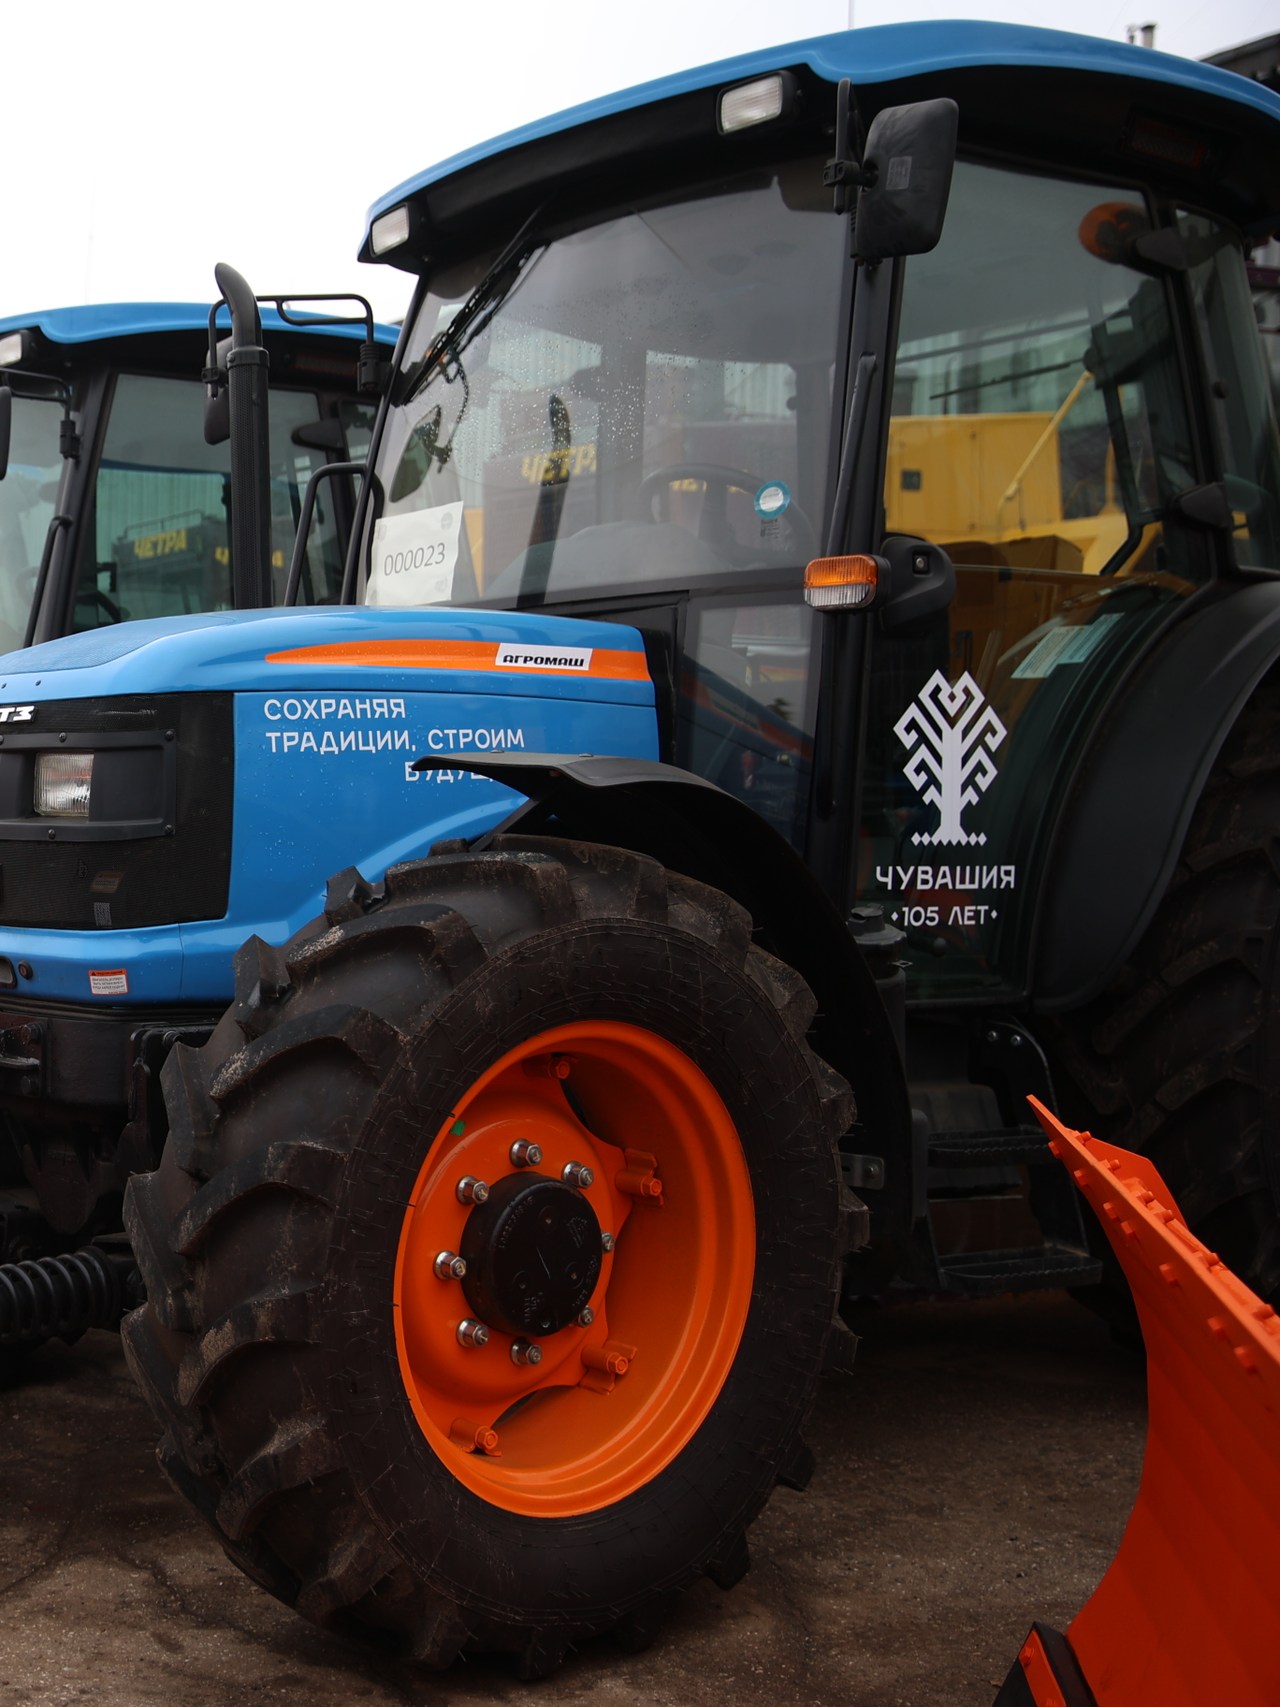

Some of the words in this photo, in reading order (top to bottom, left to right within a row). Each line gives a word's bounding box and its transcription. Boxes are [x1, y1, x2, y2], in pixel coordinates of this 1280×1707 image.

[384, 542, 446, 577] 000023
[502, 654, 585, 667] АГРОМАШ
[263, 698, 407, 721] СОХРАНЯЯ
[265, 730, 417, 754] ТРАДИЦИИ,
[427, 729, 525, 750] СТРОИМ
[875, 865, 1016, 891] ЧУВАШИЯ
[901, 906, 940, 927] 105
[948, 905, 989, 926] ЛЕТ
